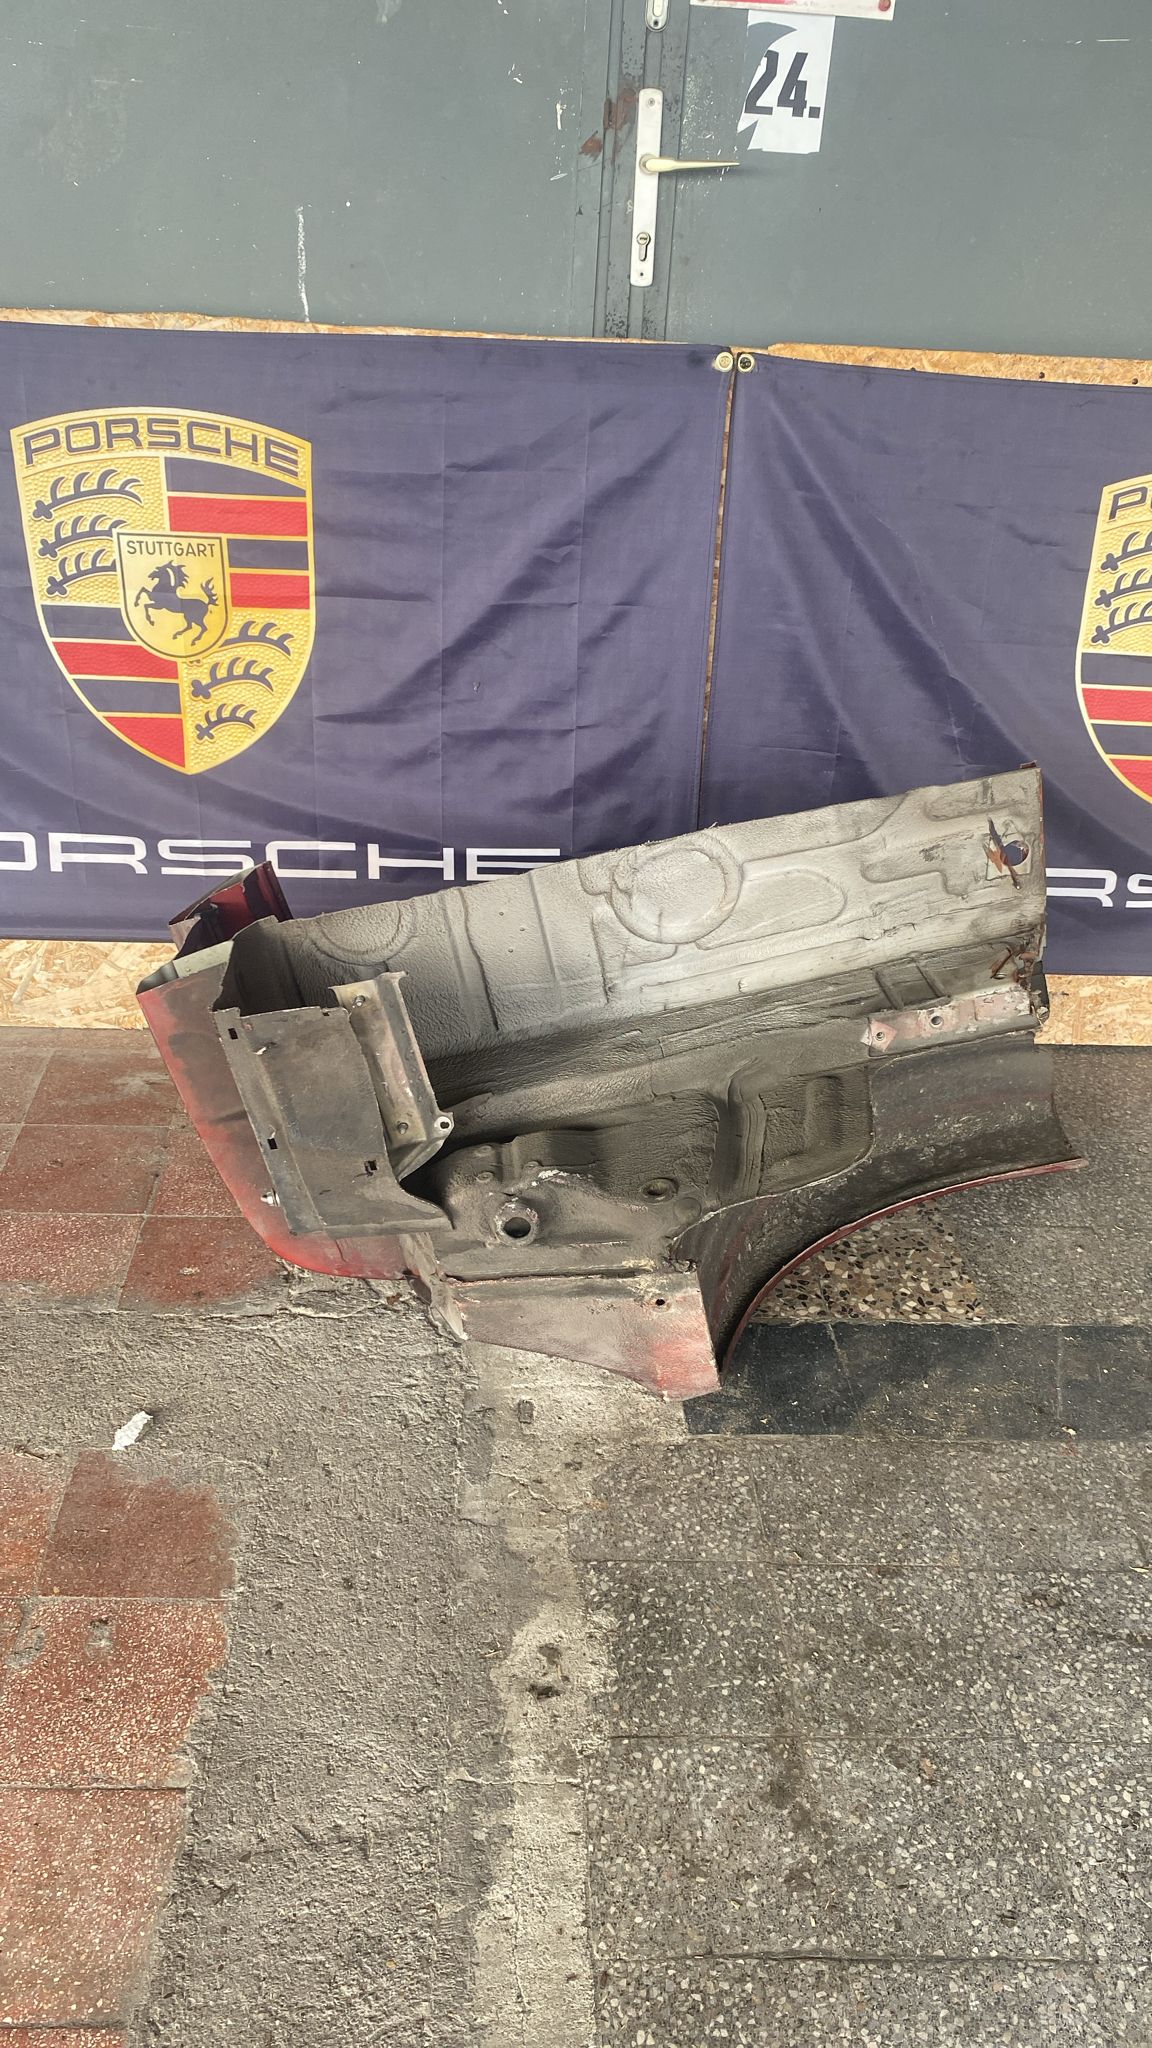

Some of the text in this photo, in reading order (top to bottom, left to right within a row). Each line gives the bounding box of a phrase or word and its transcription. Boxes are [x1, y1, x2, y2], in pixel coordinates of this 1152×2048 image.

[743, 50, 820, 119] 24.
[23, 417, 299, 478] PORSCHE
[126, 540, 215, 558] STUTTGART
